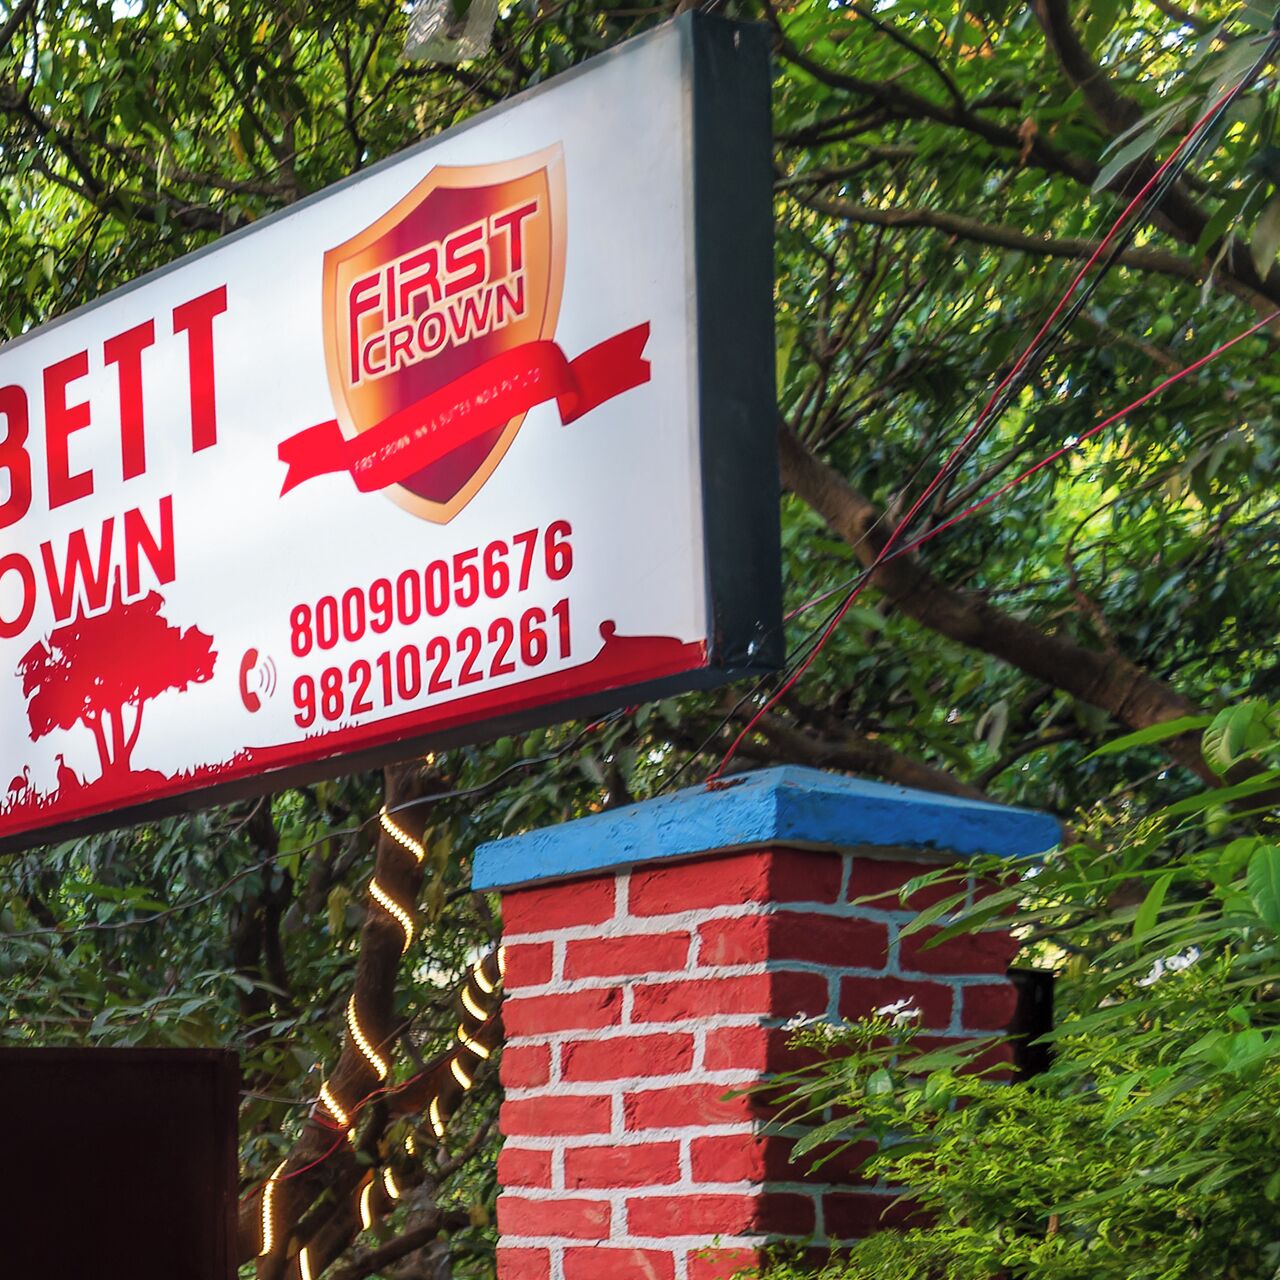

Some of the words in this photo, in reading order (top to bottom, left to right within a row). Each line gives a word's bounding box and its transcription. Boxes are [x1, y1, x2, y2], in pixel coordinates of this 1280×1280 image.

[348, 200, 539, 385] FIRST
[362, 274, 526, 376] CROWN
[289, 519, 574, 658] 8009005676
[292, 597, 572, 729] 9821022261
